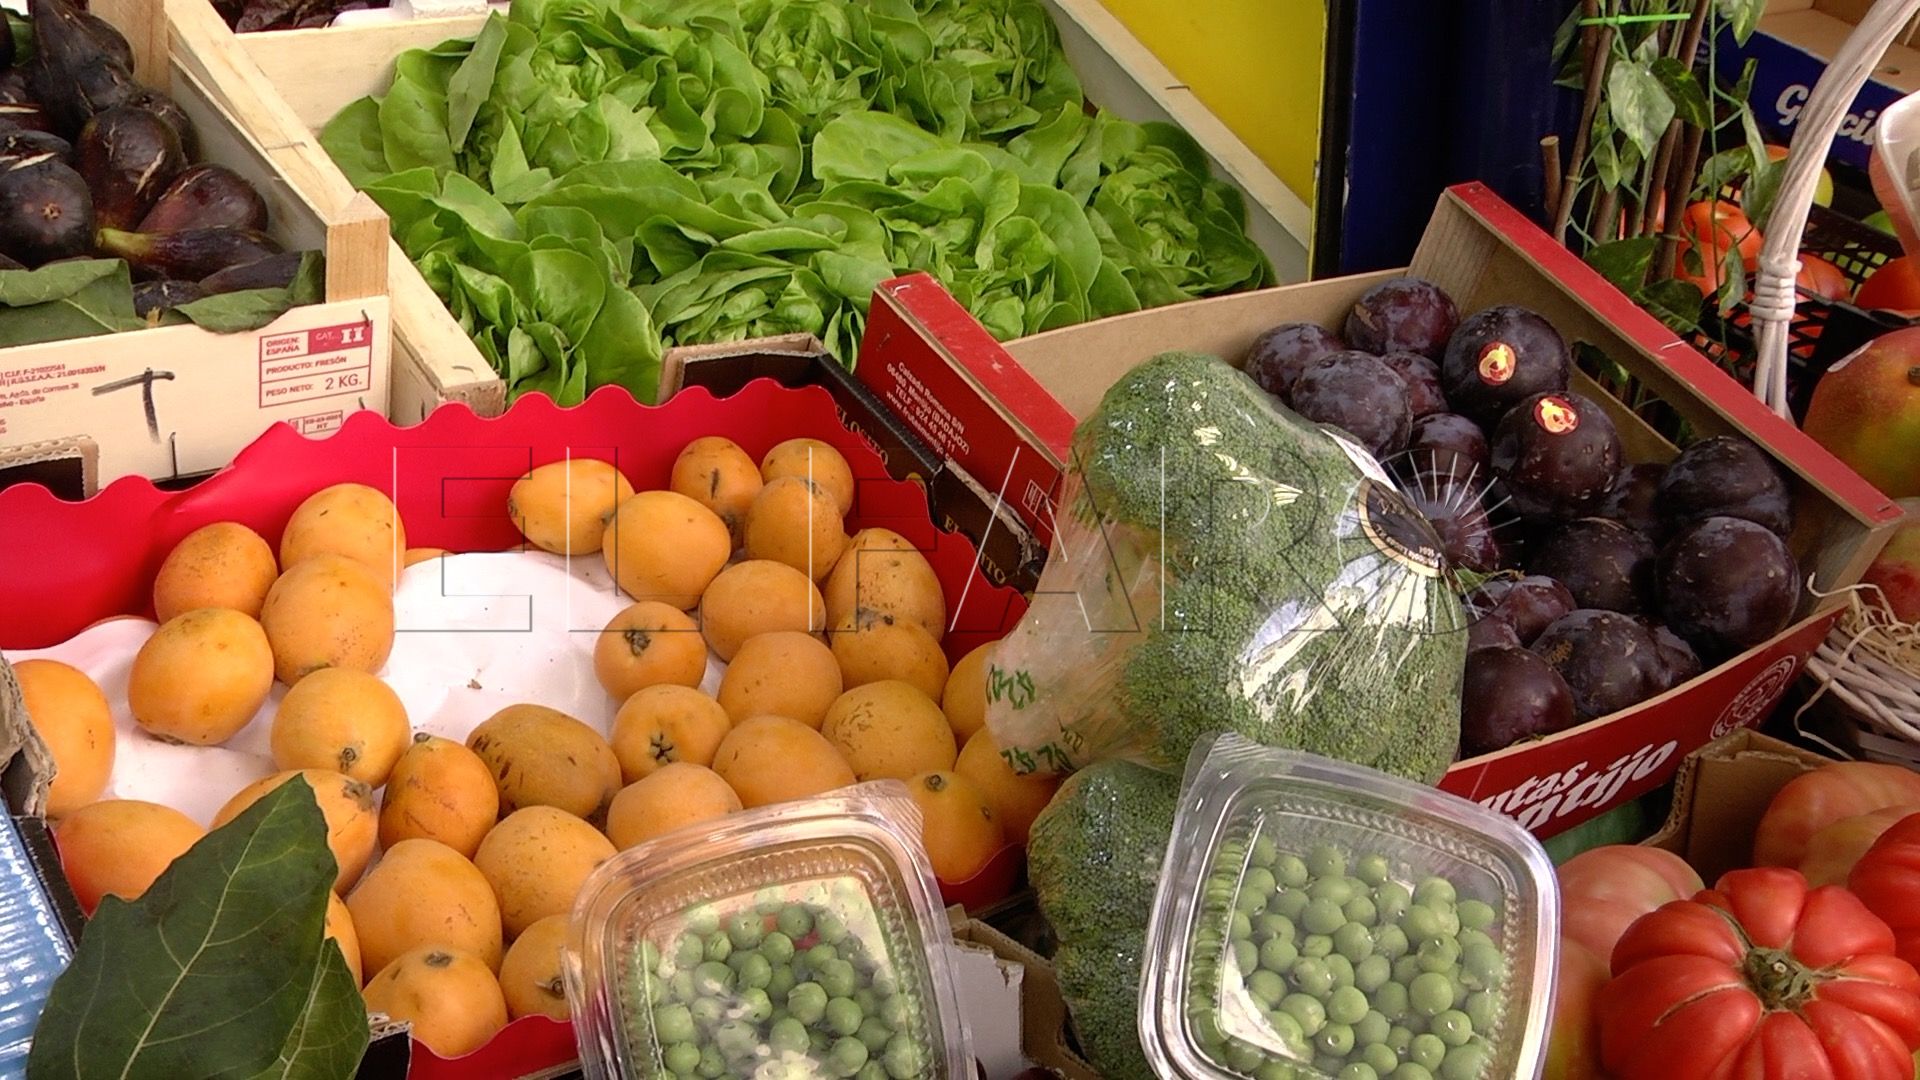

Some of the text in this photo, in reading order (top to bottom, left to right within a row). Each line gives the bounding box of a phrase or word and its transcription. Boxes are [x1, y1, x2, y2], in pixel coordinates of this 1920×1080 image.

[266, 345, 300, 355] ESPAÑA
[266, 356, 347, 375] PRODUCTO: FRESÓN
[266, 373, 362, 397] PESO NETO: 2 KG.
[1517, 739, 1679, 833] ntijo
